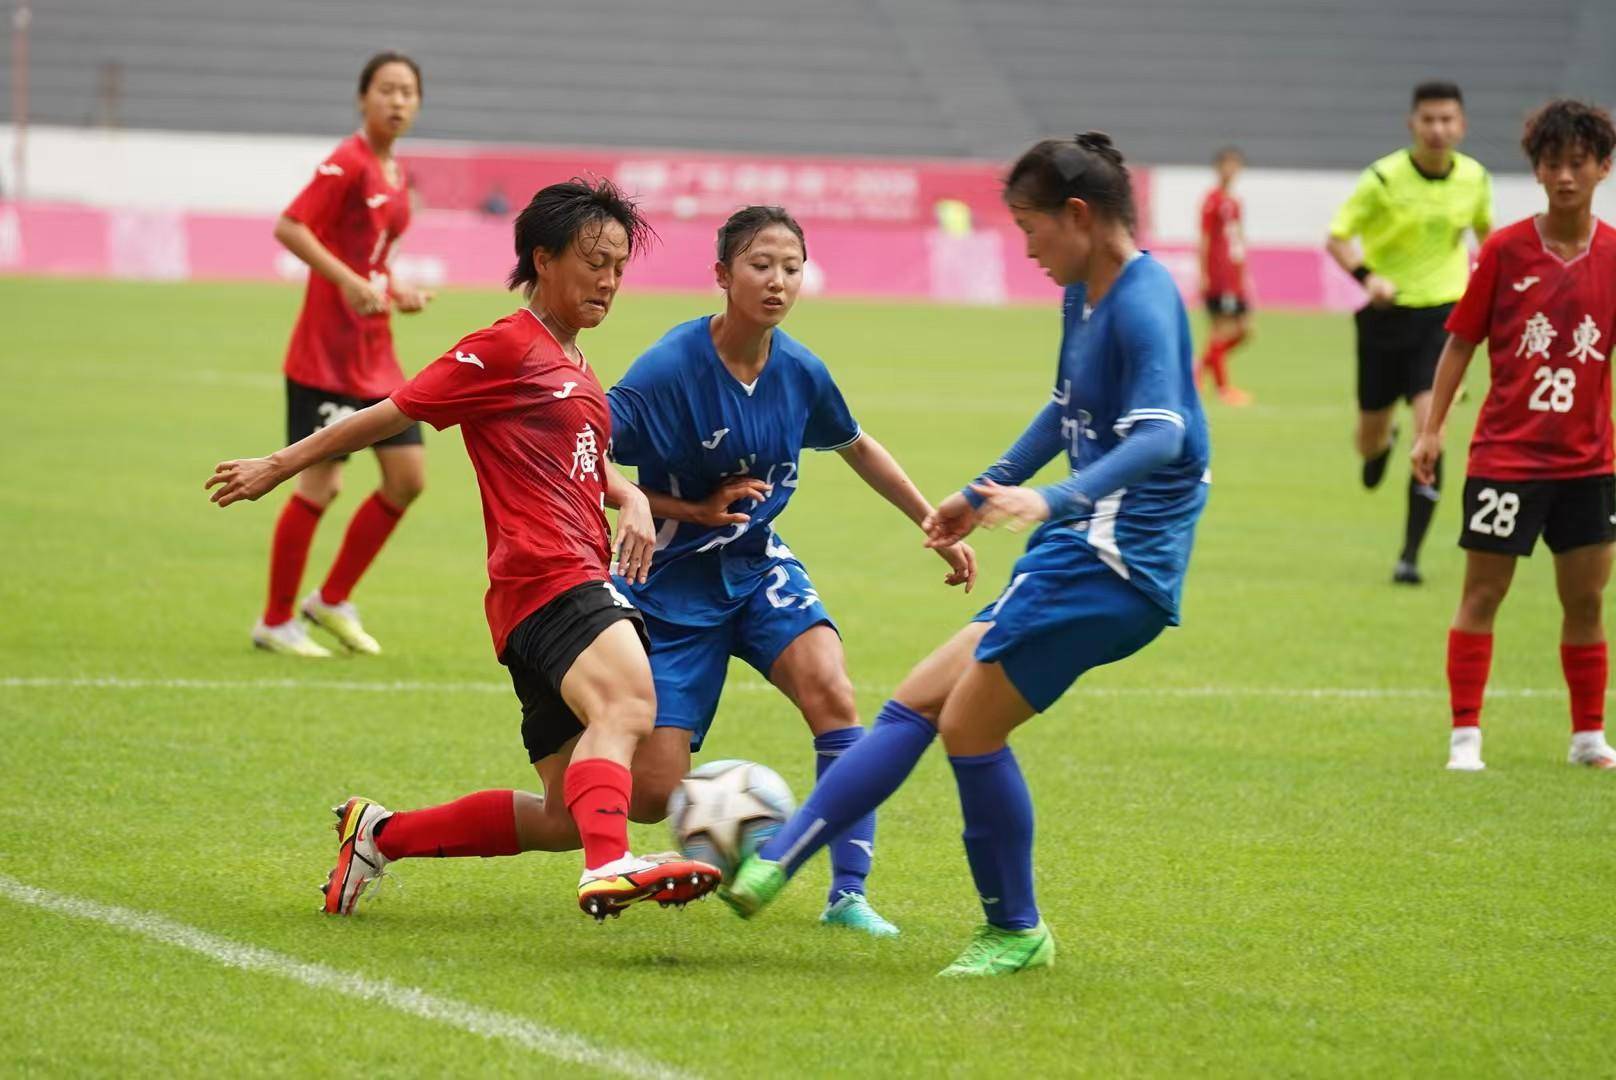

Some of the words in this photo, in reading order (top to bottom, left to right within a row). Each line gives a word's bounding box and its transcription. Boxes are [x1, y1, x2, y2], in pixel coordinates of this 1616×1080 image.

[1515, 312, 1605, 364] 廣東
[1528, 365, 1576, 413] 28
[1469, 487, 1520, 537] 28
